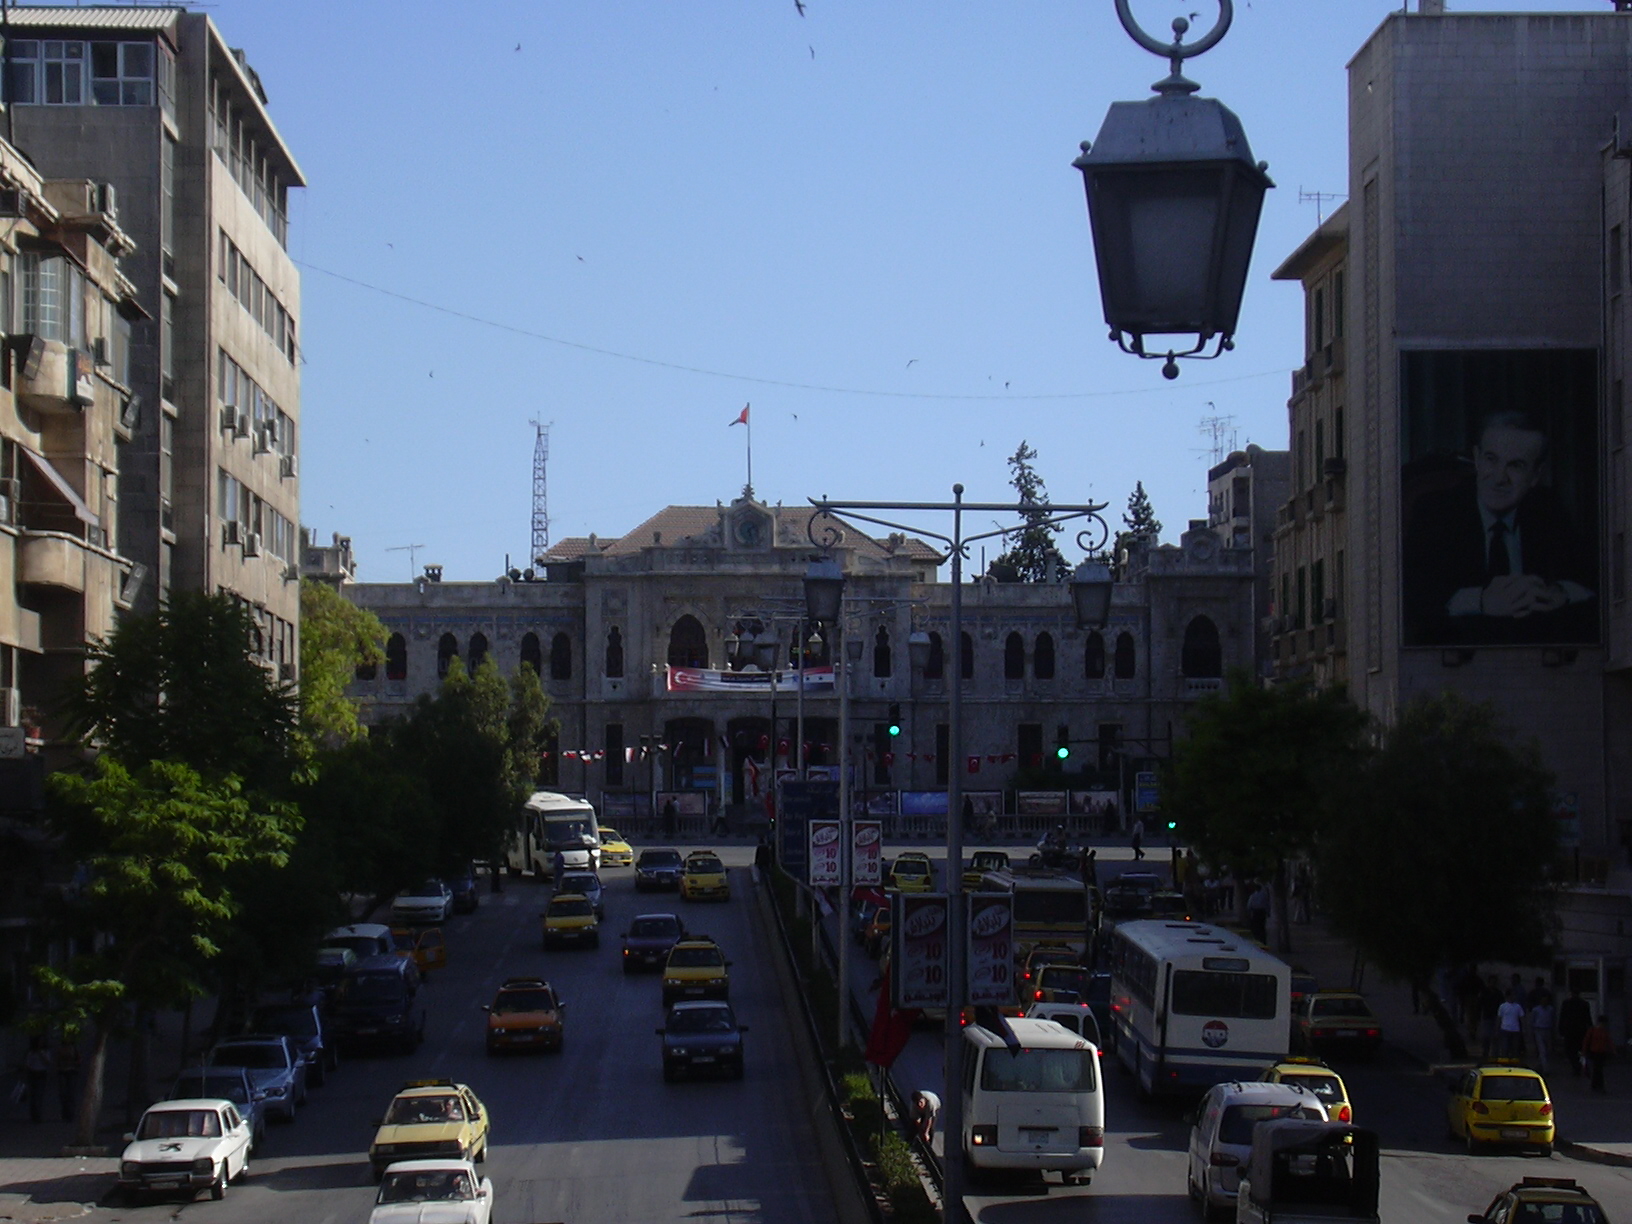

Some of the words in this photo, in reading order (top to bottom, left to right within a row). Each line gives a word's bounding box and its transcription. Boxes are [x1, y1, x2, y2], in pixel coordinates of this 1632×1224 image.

[825, 847, 837, 859] 10
[825, 861, 837, 873] 10
[867, 862, 878, 874] 10
[925, 941, 942, 960] 10
[992, 940, 1007, 959] 10
[925, 964, 942, 984] 10
[992, 964, 1007, 983] 10
